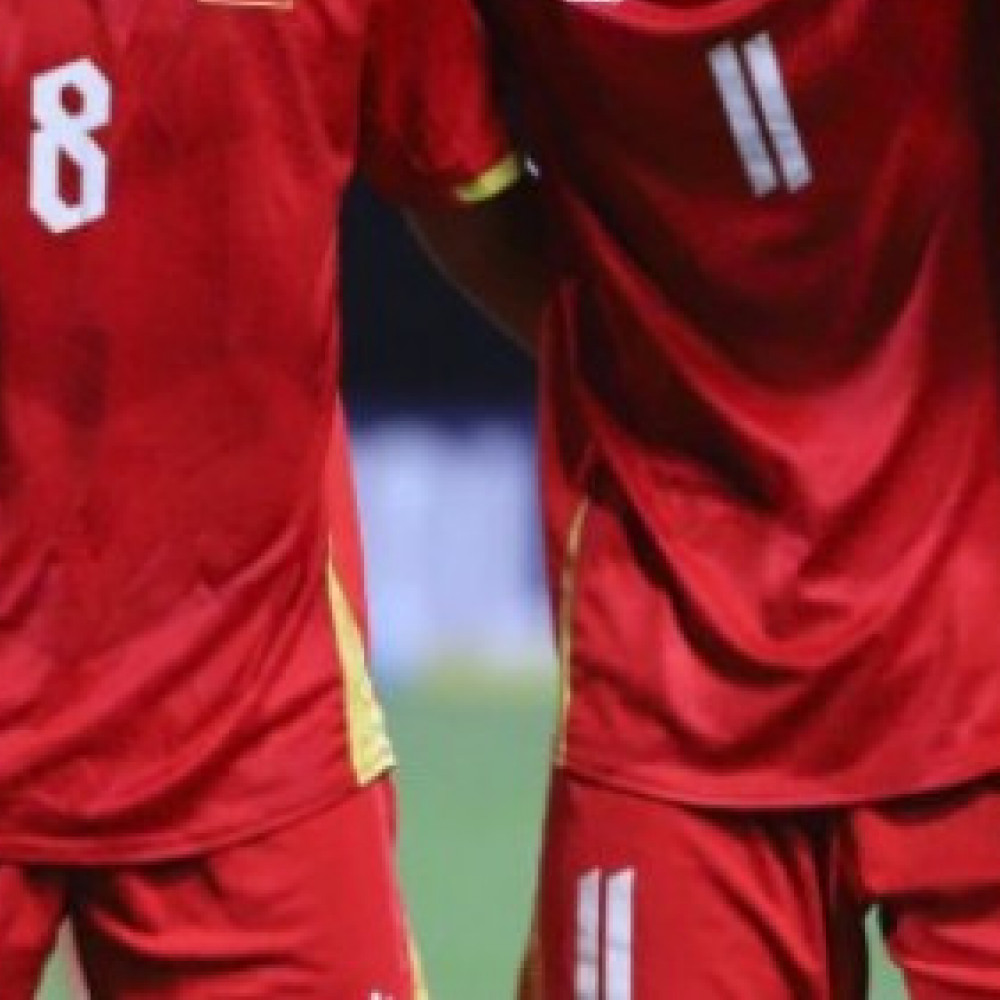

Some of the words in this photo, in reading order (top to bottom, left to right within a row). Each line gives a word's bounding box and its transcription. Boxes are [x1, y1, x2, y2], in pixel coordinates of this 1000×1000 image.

[29, 57, 112, 233] 8
[706, 31, 813, 196] 11
[574, 866, 634, 1000] 11
